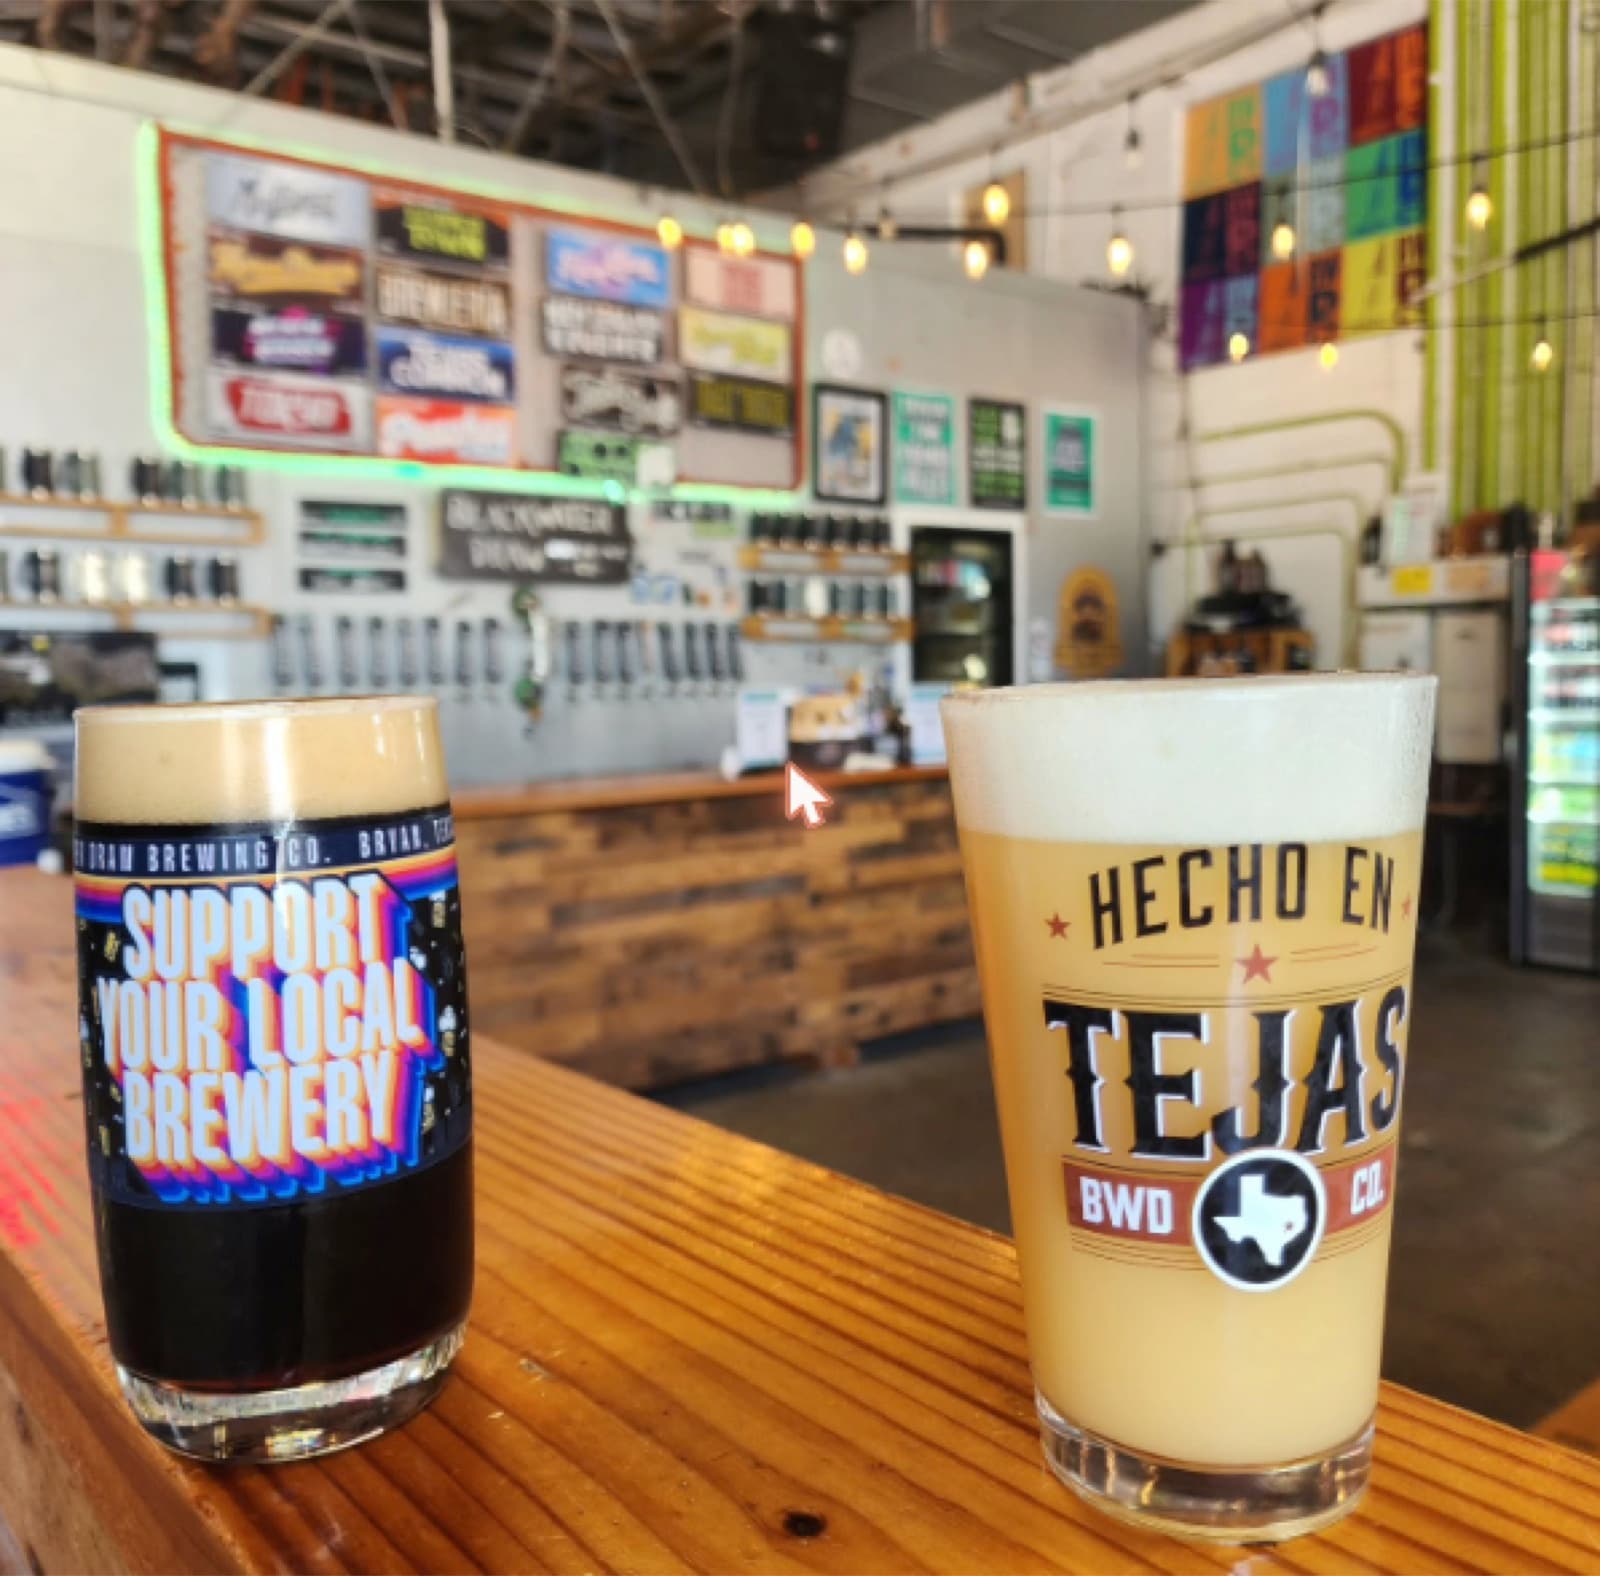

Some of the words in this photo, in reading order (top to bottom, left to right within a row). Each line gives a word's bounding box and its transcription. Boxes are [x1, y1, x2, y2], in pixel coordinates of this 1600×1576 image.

[147, 840, 269, 872] BREWING
[288, 836, 331, 867] CO.
[1089, 842, 1307, 948] HECHO
[1341, 845, 1395, 934] EN
[123, 872, 380, 979] SUPPORT
[97, 975, 226, 1073] YOUR
[246, 957, 423, 1068] LOCAL
[122, 1050, 394, 1164] BREWERY
[1042, 985, 1408, 1162] TEJAS
[1078, 1175, 1175, 1235] BWD
[1349, 1160, 1384, 1216] CO.
